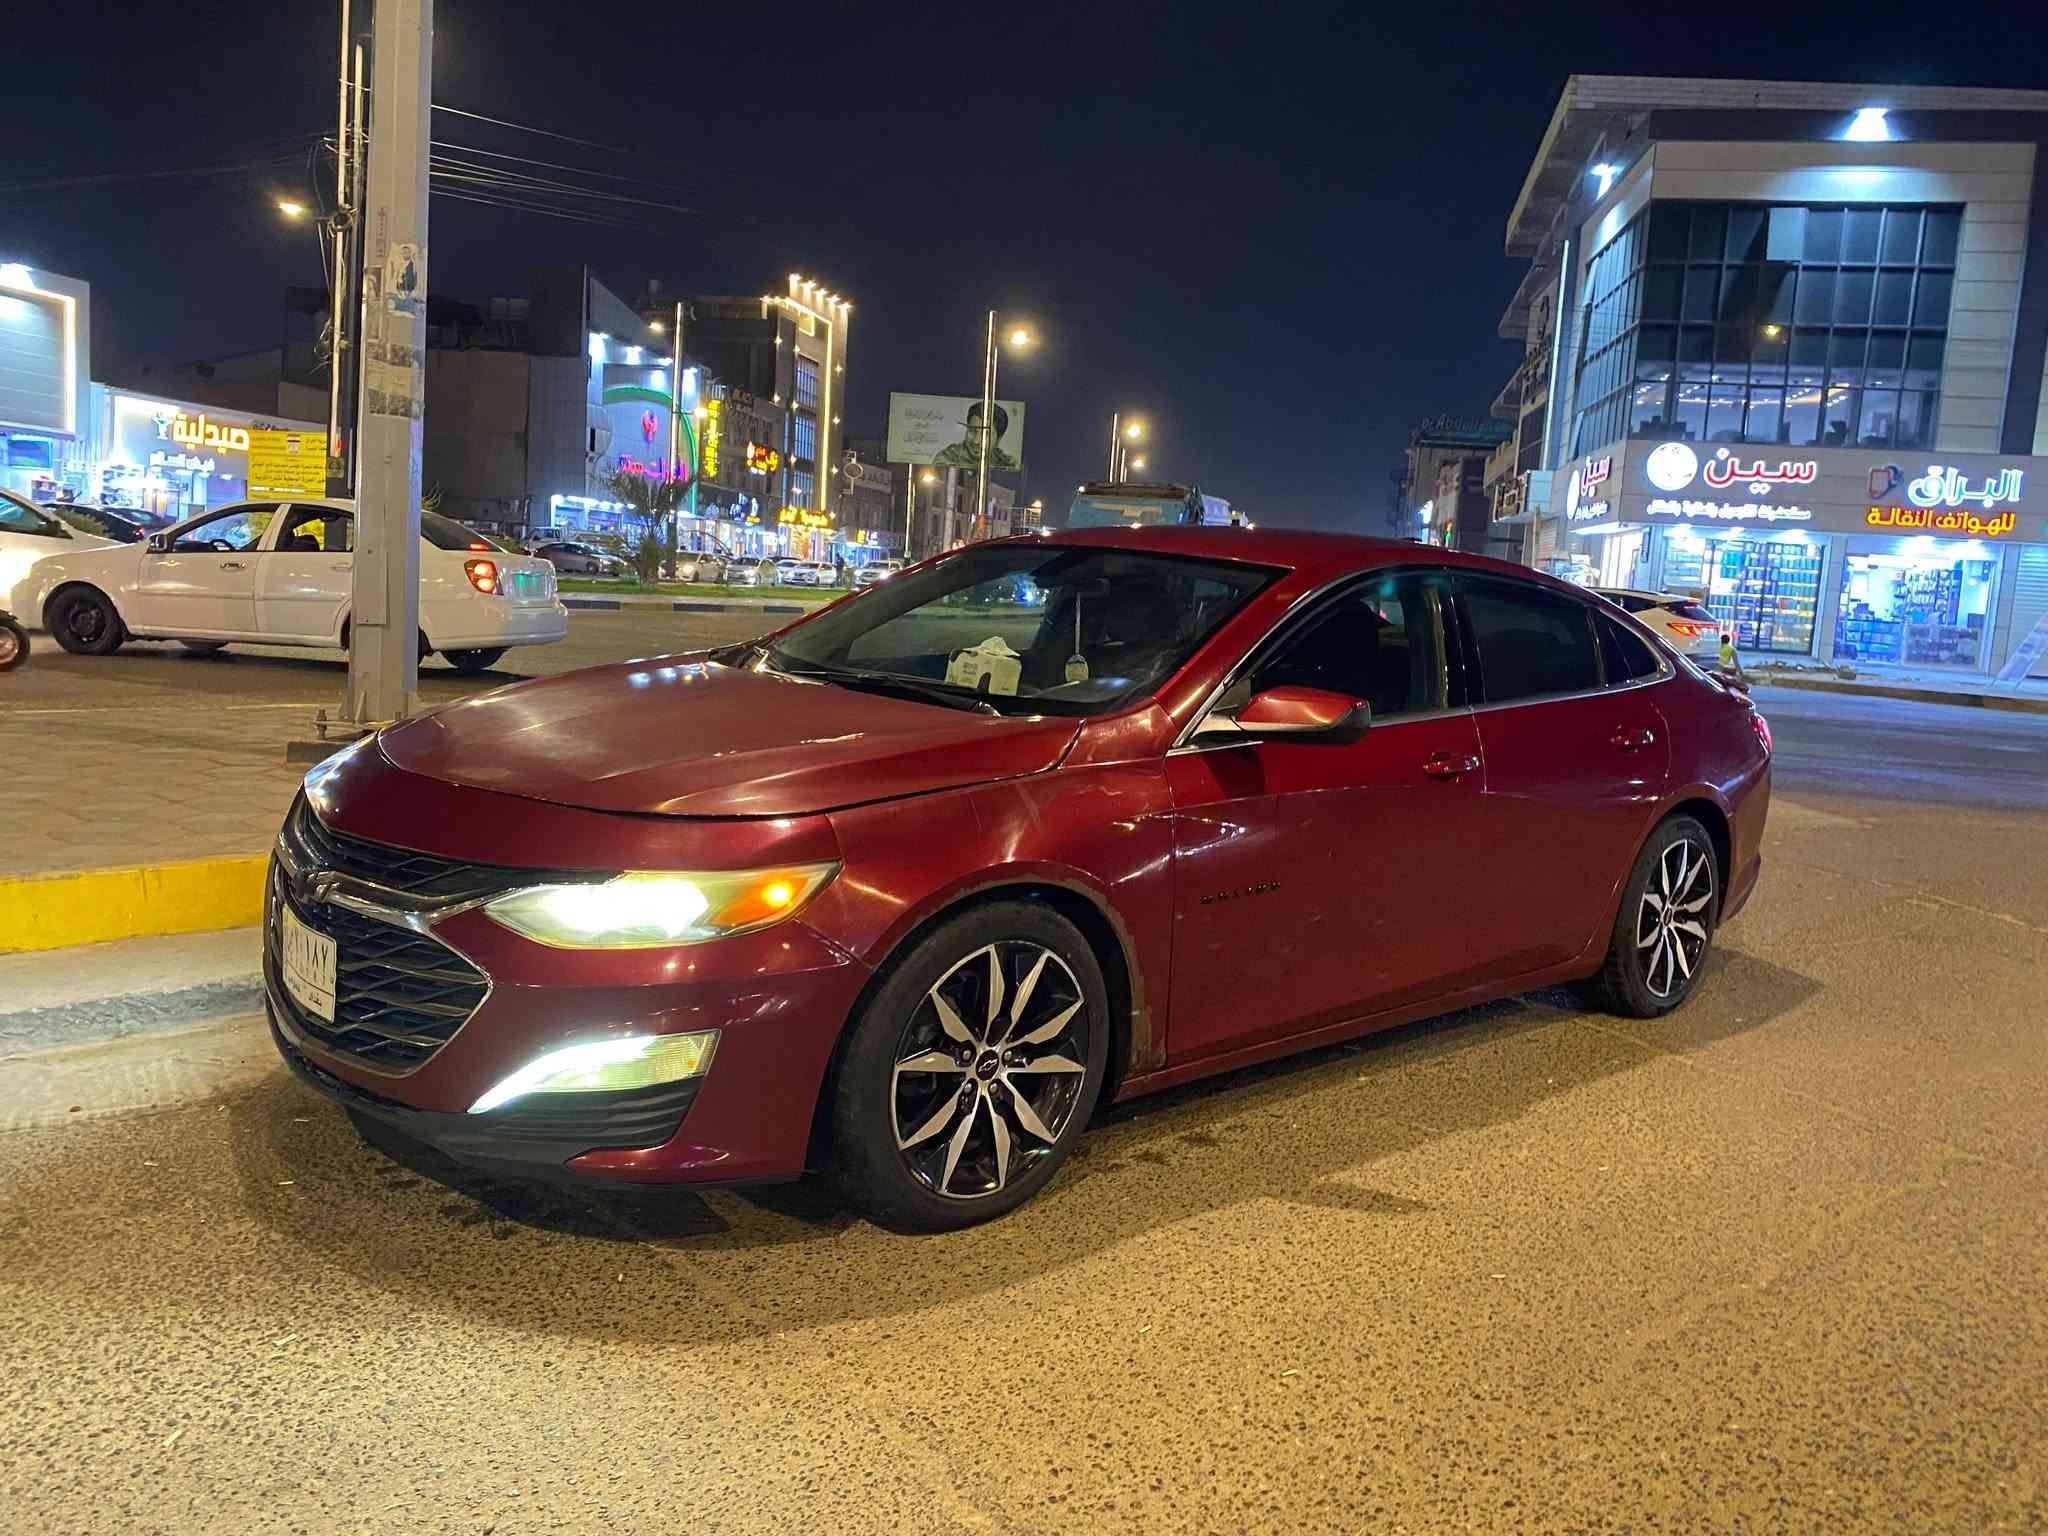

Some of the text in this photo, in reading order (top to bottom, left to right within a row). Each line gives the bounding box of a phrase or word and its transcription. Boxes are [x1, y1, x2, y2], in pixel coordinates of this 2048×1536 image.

[172, 412, 249, 454] صيدلية
[1703, 447, 1817, 495] سين
[1908, 465, 2024, 508] البراق
[1867, 507, 2016, 537] للهواتف النقالة
